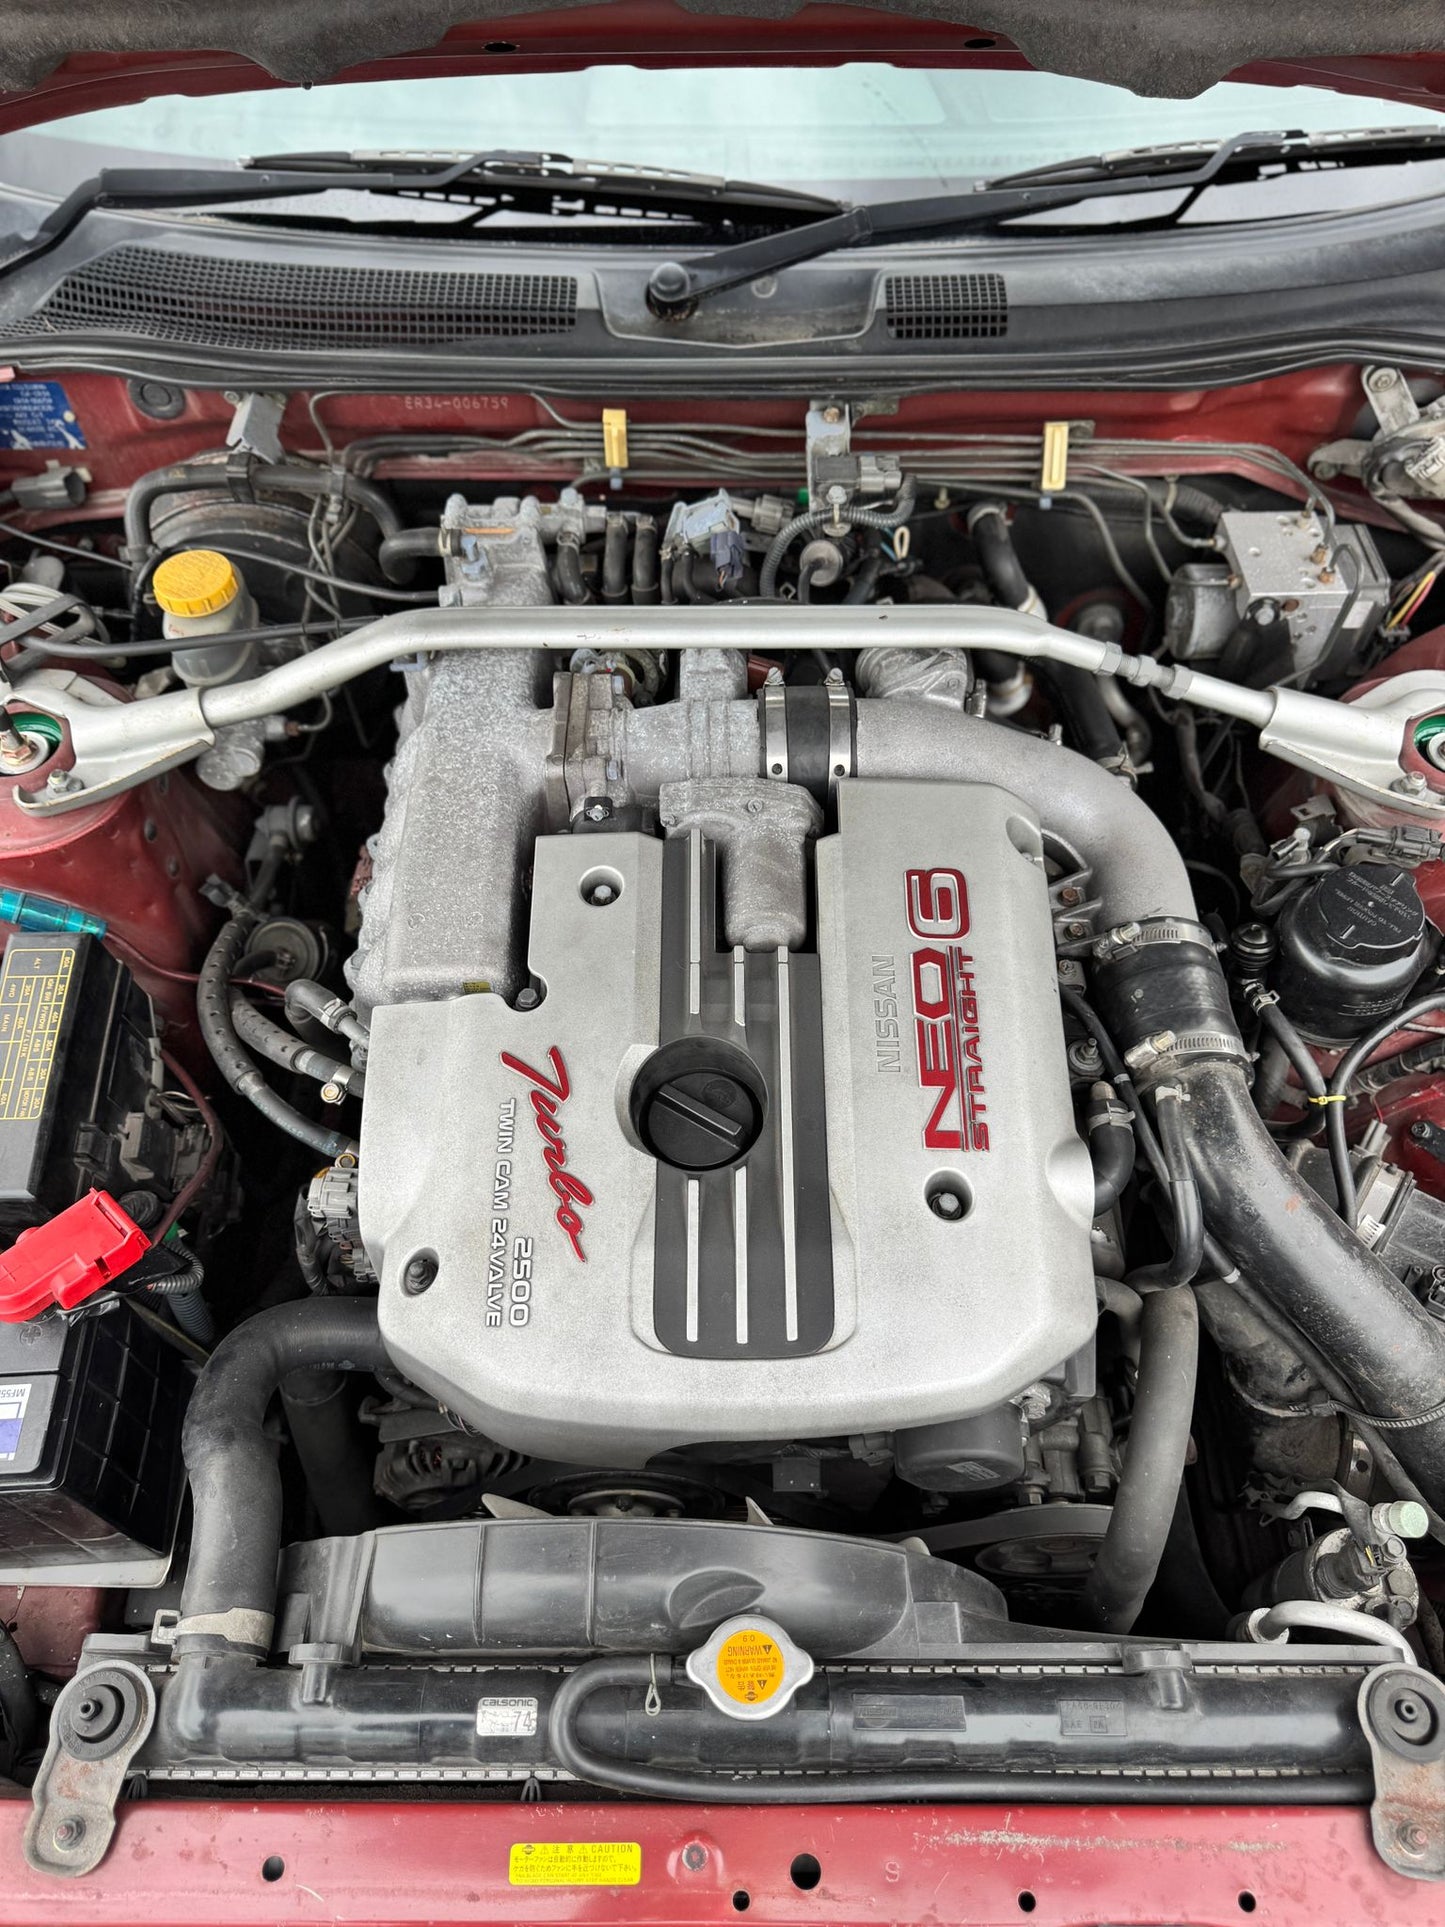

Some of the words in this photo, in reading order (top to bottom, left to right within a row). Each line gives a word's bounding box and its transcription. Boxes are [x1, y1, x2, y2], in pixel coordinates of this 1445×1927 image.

[33, 957, 42, 969] ALT
[1, 1013, 11, 1032] MAIN
[872, 954, 901, 1073] NISSAN
[19, 1029, 31, 1058] F/LINK
[32, 1039, 41, 1052] ABS
[957, 946, 990, 1153] STRAIGHT
[26, 1068, 35, 1081] ABS
[497, 1098, 517, 1153] TWIN
[499, 1044, 596, 1263] Turbo
[492, 1160, 512, 1211] CAM
[485, 1218, 508, 1328] 24VALVE
[509, 1236, 534, 1328] 2500
[0, 1388, 26, 1398] MF55
[727, 1646, 762, 1657] WARNING
[591, 1844, 634, 1853] CAUTION
